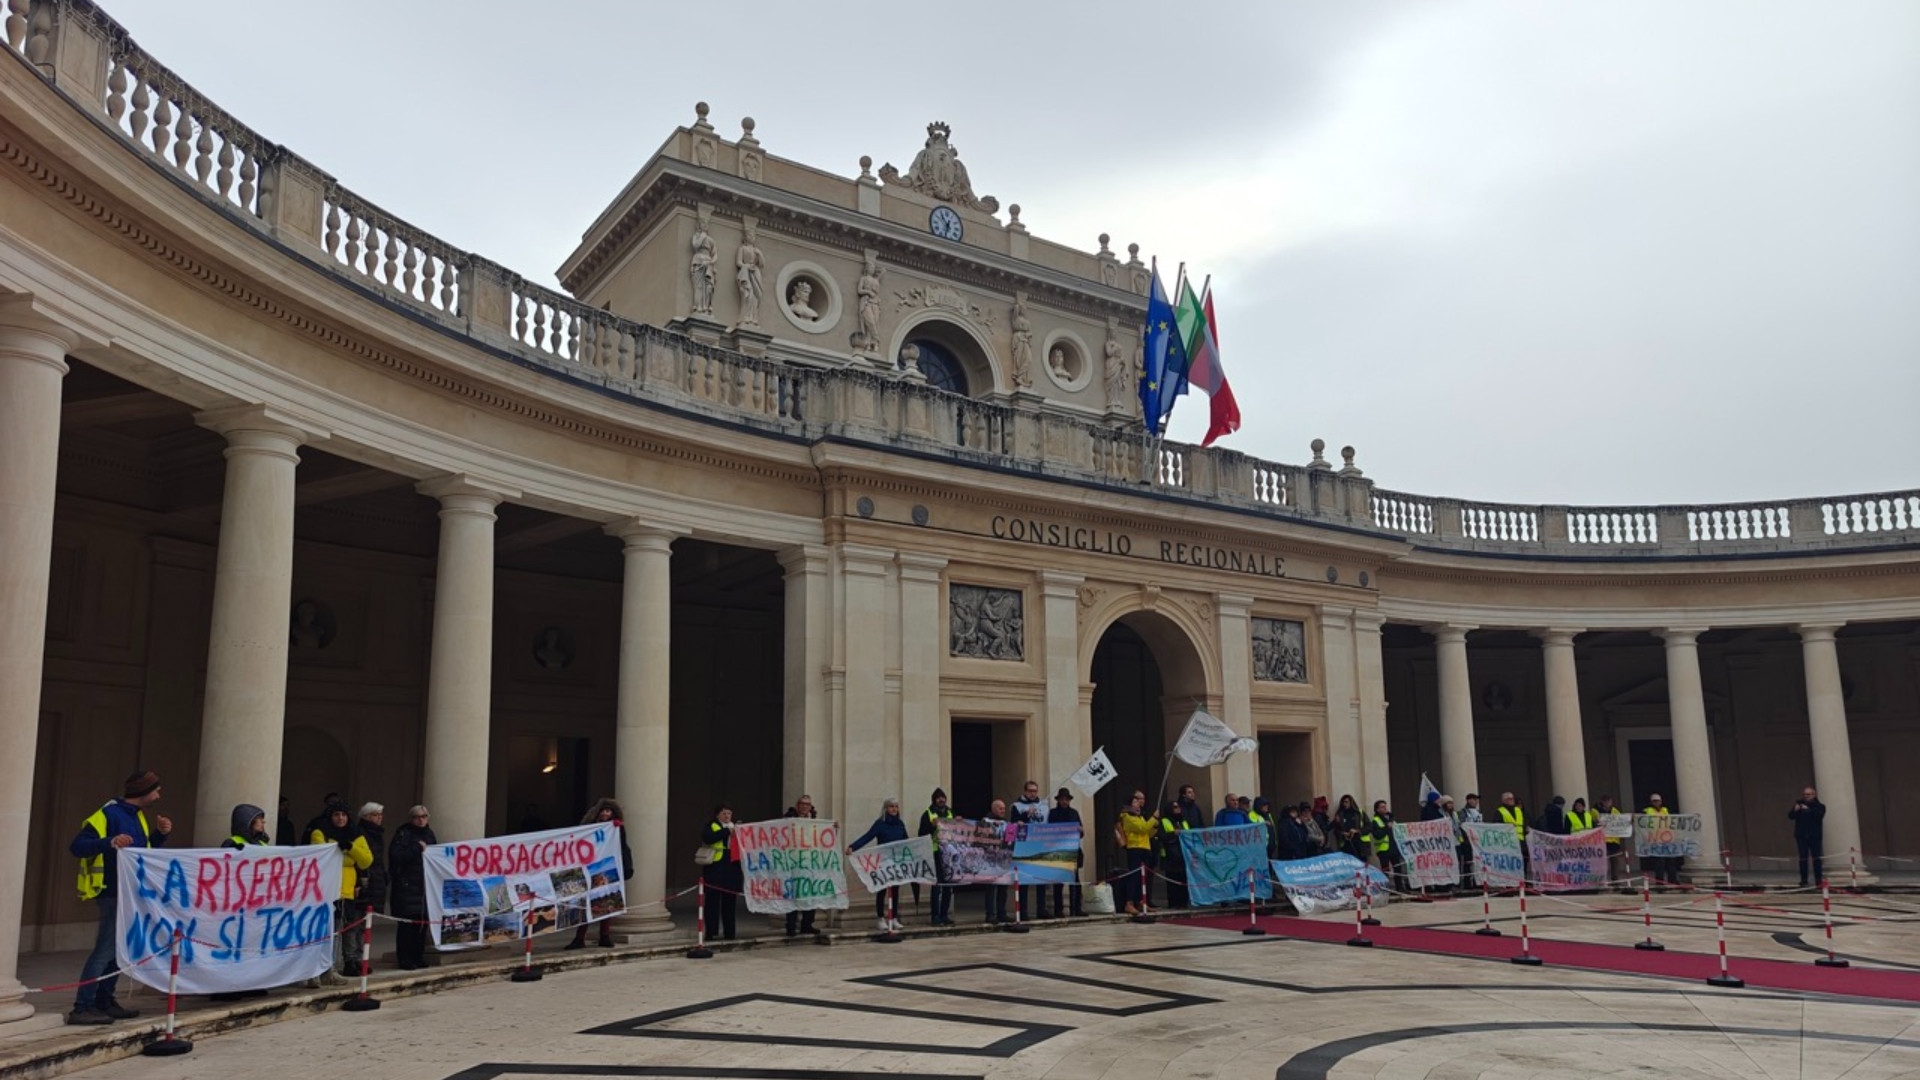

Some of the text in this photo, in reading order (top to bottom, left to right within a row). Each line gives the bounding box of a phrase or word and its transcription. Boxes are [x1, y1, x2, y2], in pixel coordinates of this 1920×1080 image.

[992, 515, 1286, 578] CONSIGLIO REGIONALE
[1637, 815, 1702, 832] CEMENTO
[740, 822, 836, 851] MARSILIO
[1202, 826, 1263, 847] RISERVA
[1405, 837, 1452, 854] TURISMO
[1480, 829, 1518, 849] VERDE
[1638, 839, 1697, 855] GRAZIE
[1647, 830, 1673, 843] NO
[747, 848, 841, 872] LA RISERVA
[891, 845, 914, 863] LA
[136, 853, 323, 913] LA RISERVA
[869, 860, 935, 886] RISERVA
[794, 876, 835, 898] TOCCA
[126, 912, 197, 963] NON
[211, 907, 245, 962] SI
